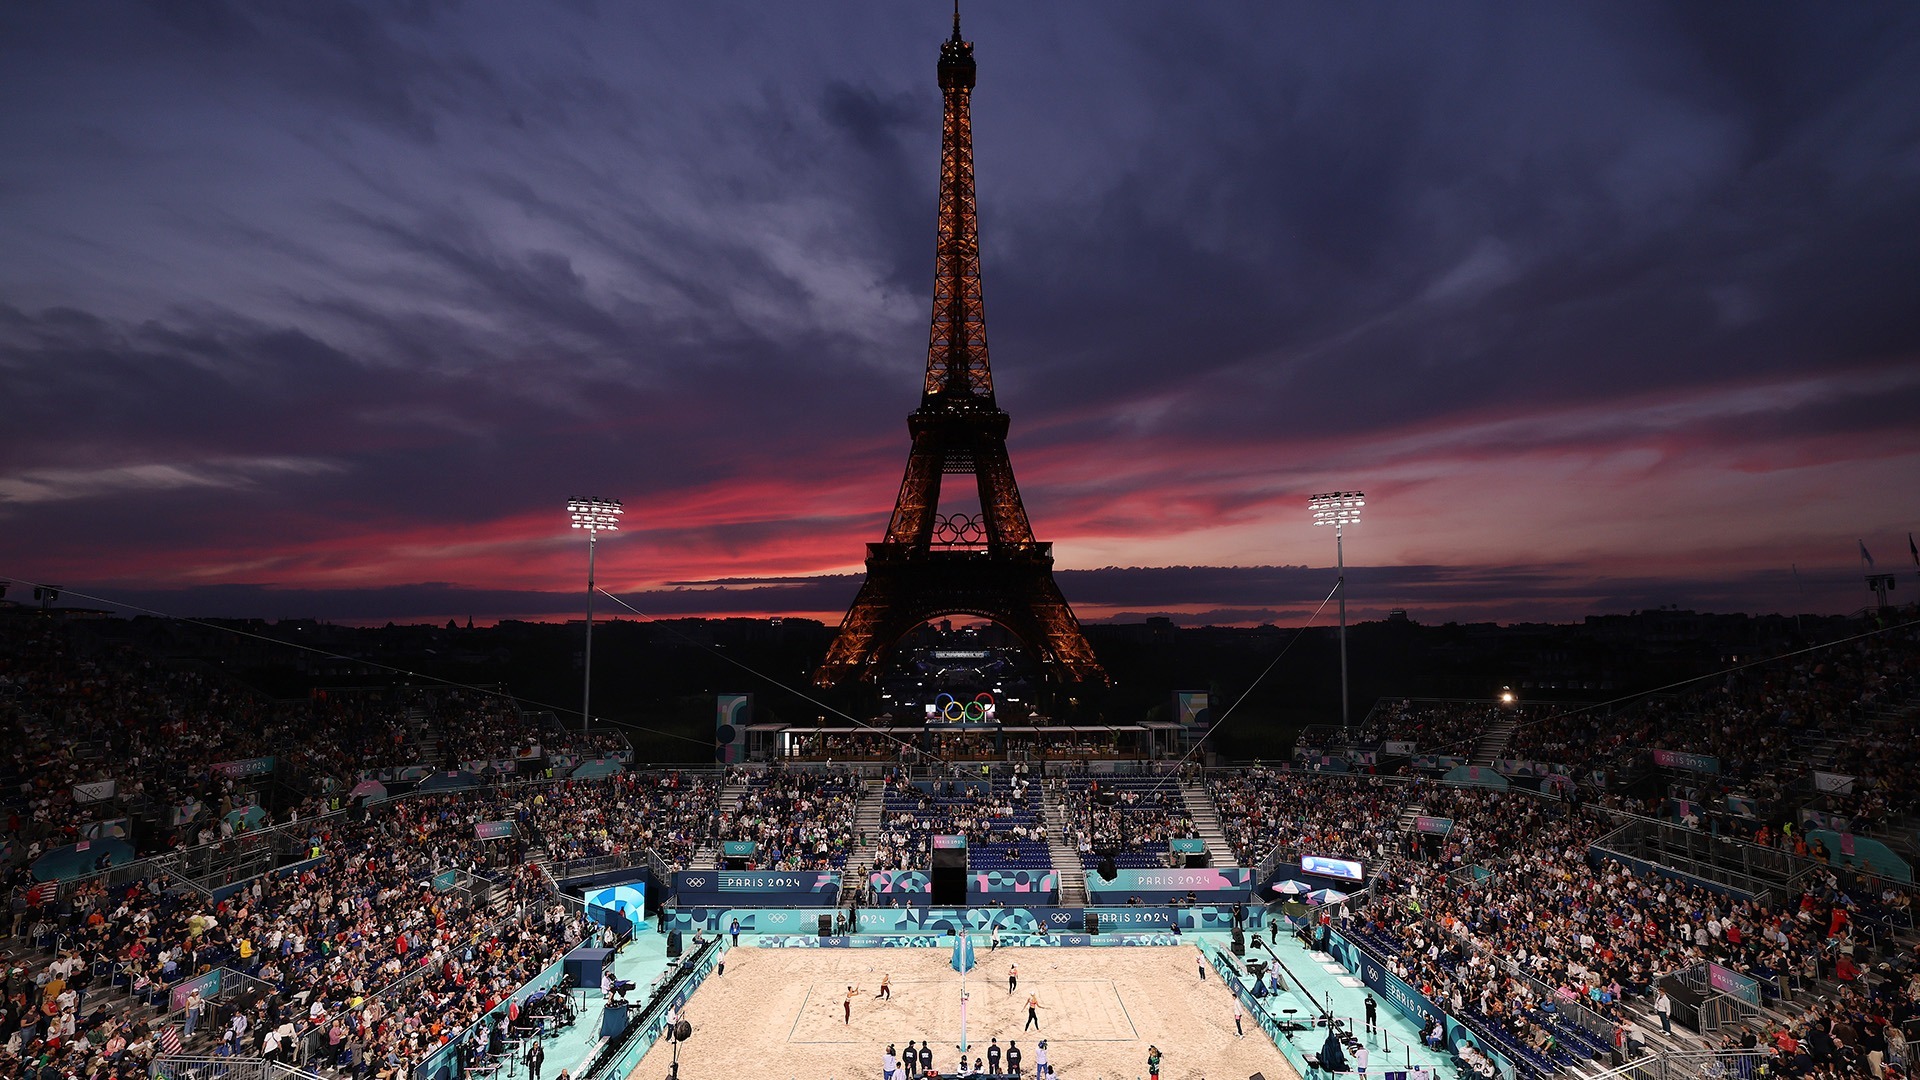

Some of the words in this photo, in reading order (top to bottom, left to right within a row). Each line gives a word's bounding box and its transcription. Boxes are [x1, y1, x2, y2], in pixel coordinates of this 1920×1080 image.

[768, 878, 800, 887] 2024
[1178, 876, 1210, 885] 2024
[860, 914, 885, 924] 024
[1098, 913, 1130, 923] ARIS
[1135, 913, 1168, 923] 2024
